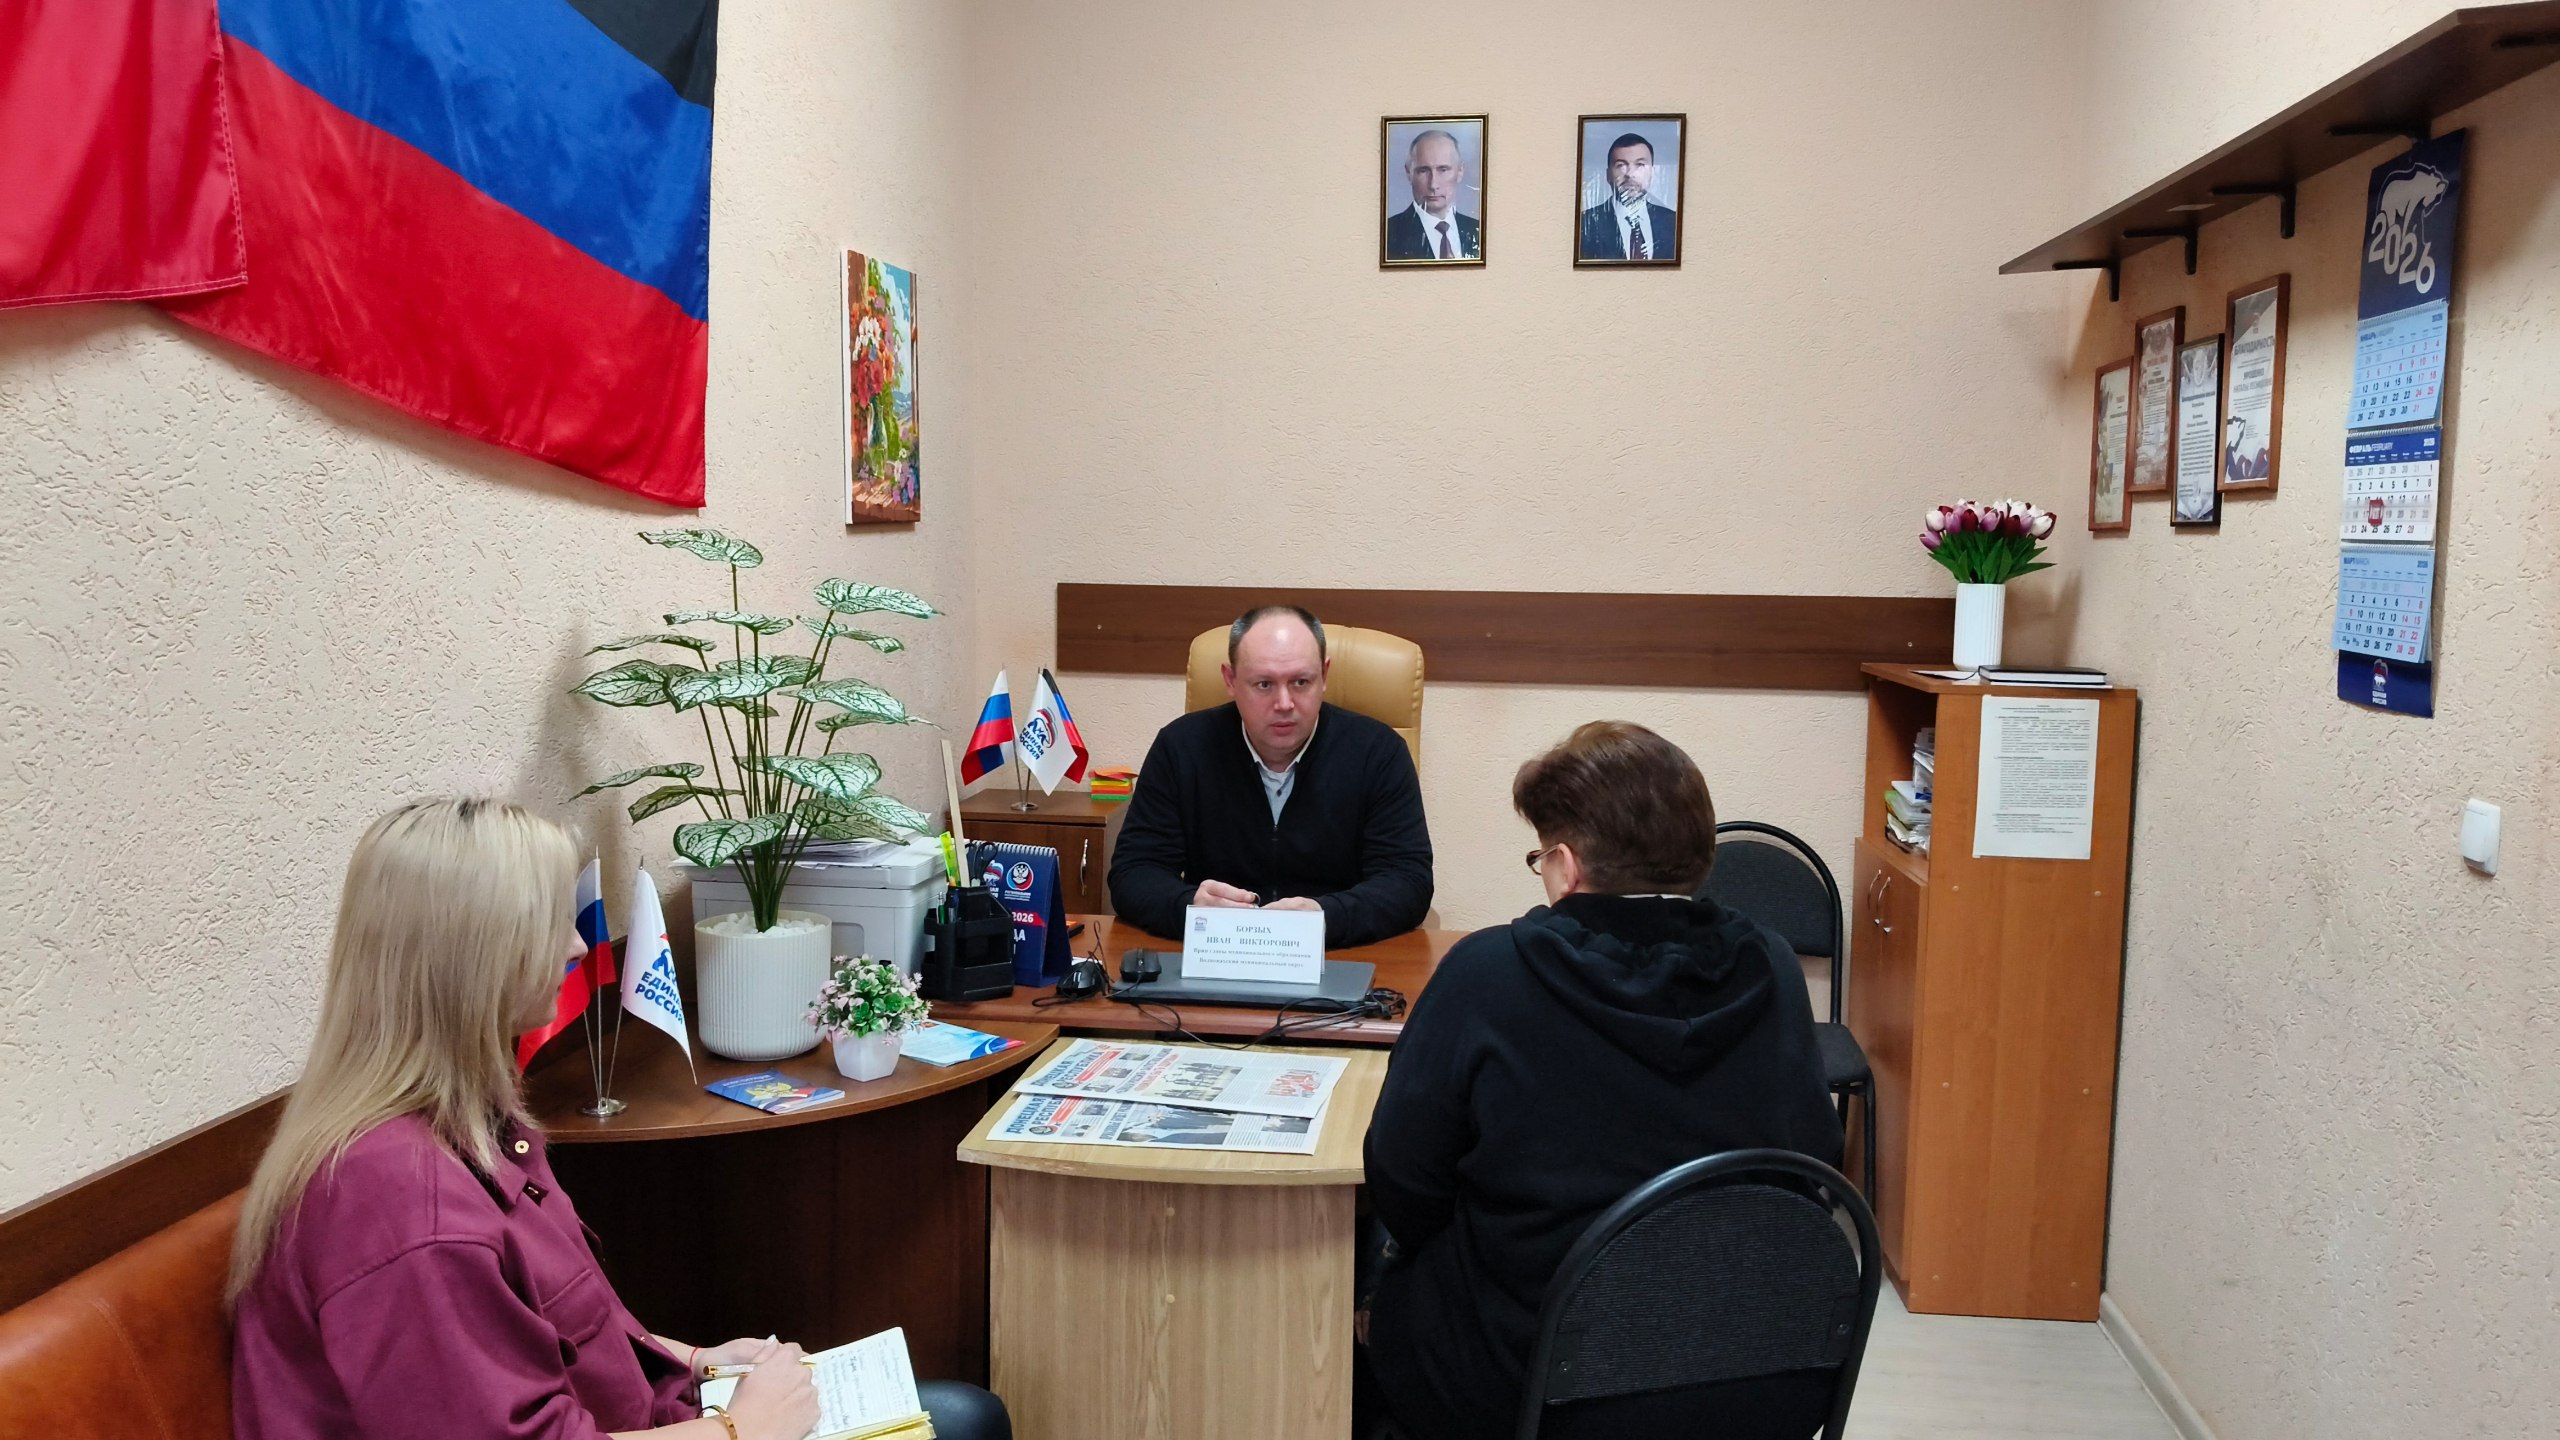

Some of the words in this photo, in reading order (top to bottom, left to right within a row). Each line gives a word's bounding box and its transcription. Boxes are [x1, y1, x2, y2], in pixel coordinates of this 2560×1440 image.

[2368, 212, 2435, 294] 2026
[1011, 911, 1034, 923] 2026
[1236, 925, 1272, 934] БОРЗЫХ
[1206, 936, 1231, 944] ИВАН
[1239, 938, 1300, 947] ВИКТОРОВИЧ
[1006, 1097, 1047, 1134] ДОНЕЦКАЯ
[1032, 1095, 1066, 1125] РЕСПУБЛ
